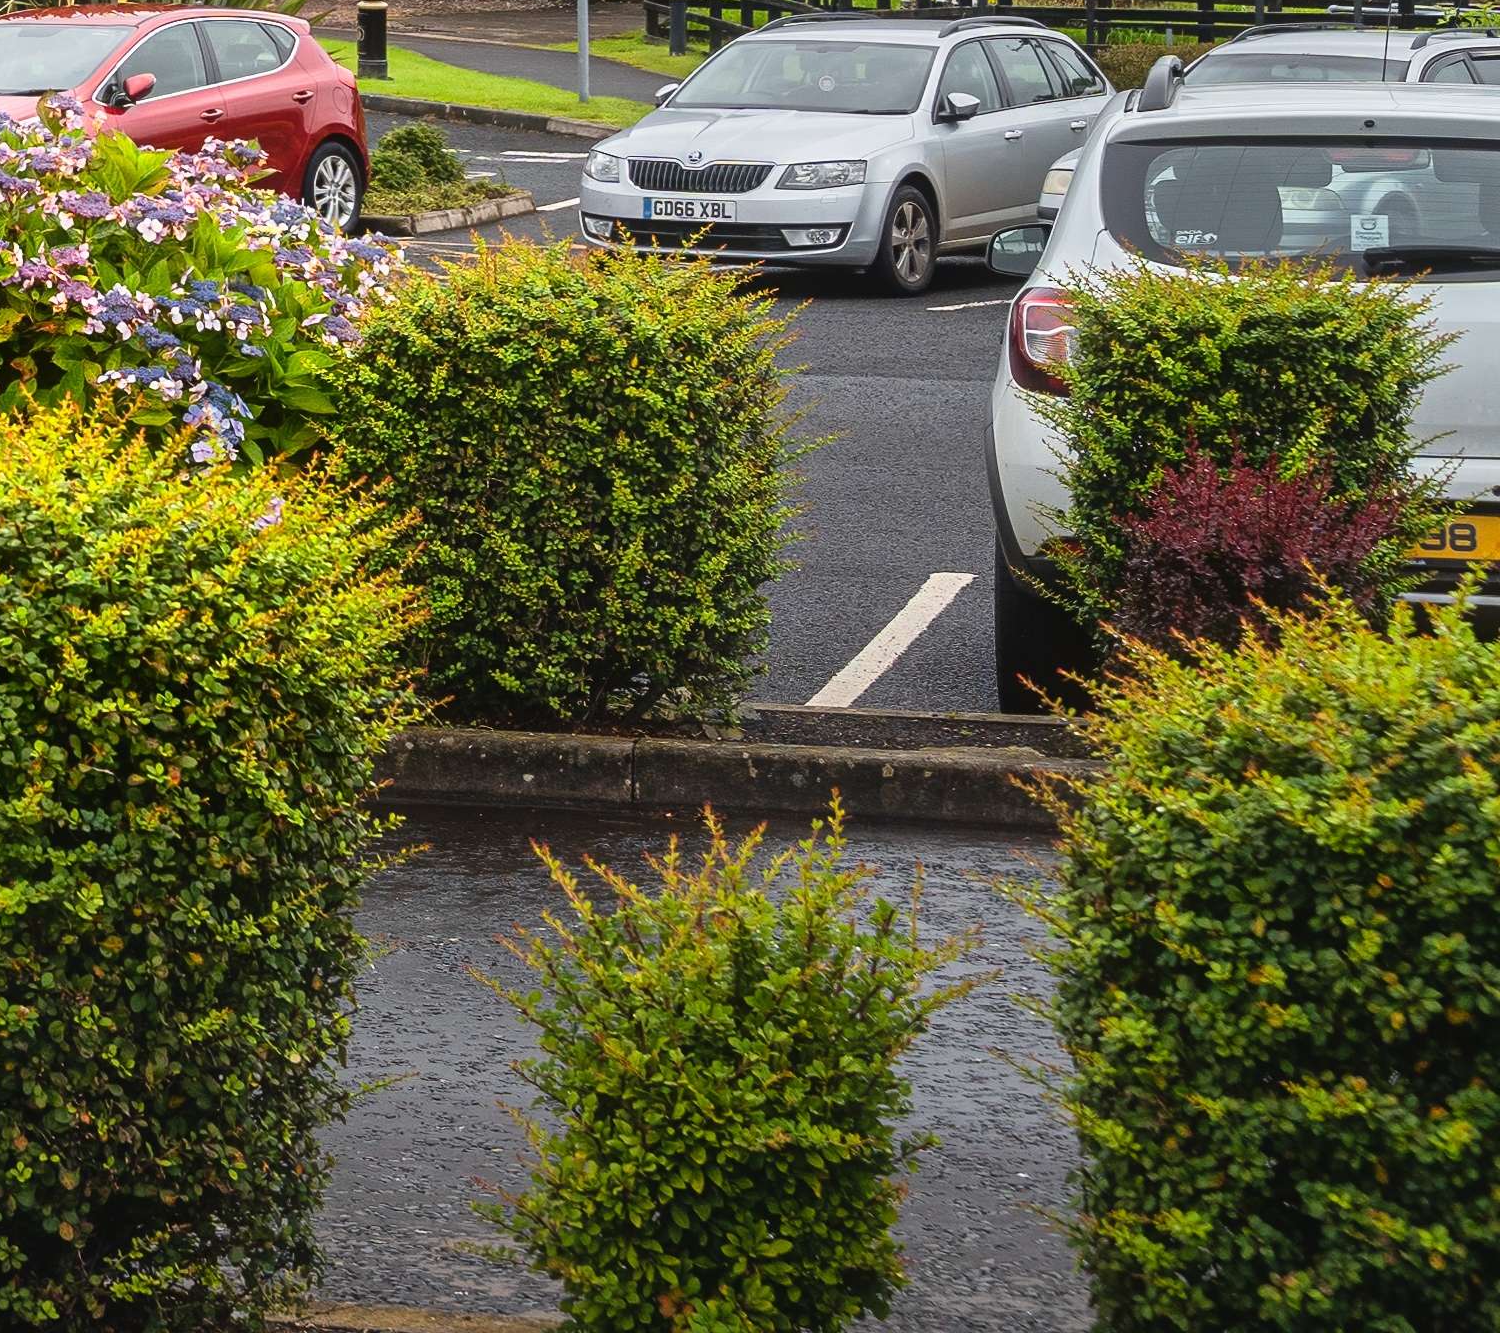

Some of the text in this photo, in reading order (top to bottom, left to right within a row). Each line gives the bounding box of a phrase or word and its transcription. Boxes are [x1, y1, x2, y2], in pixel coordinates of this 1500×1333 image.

[654, 200, 732, 219] GD66 XBL
[1175, 235, 1204, 244] elf
